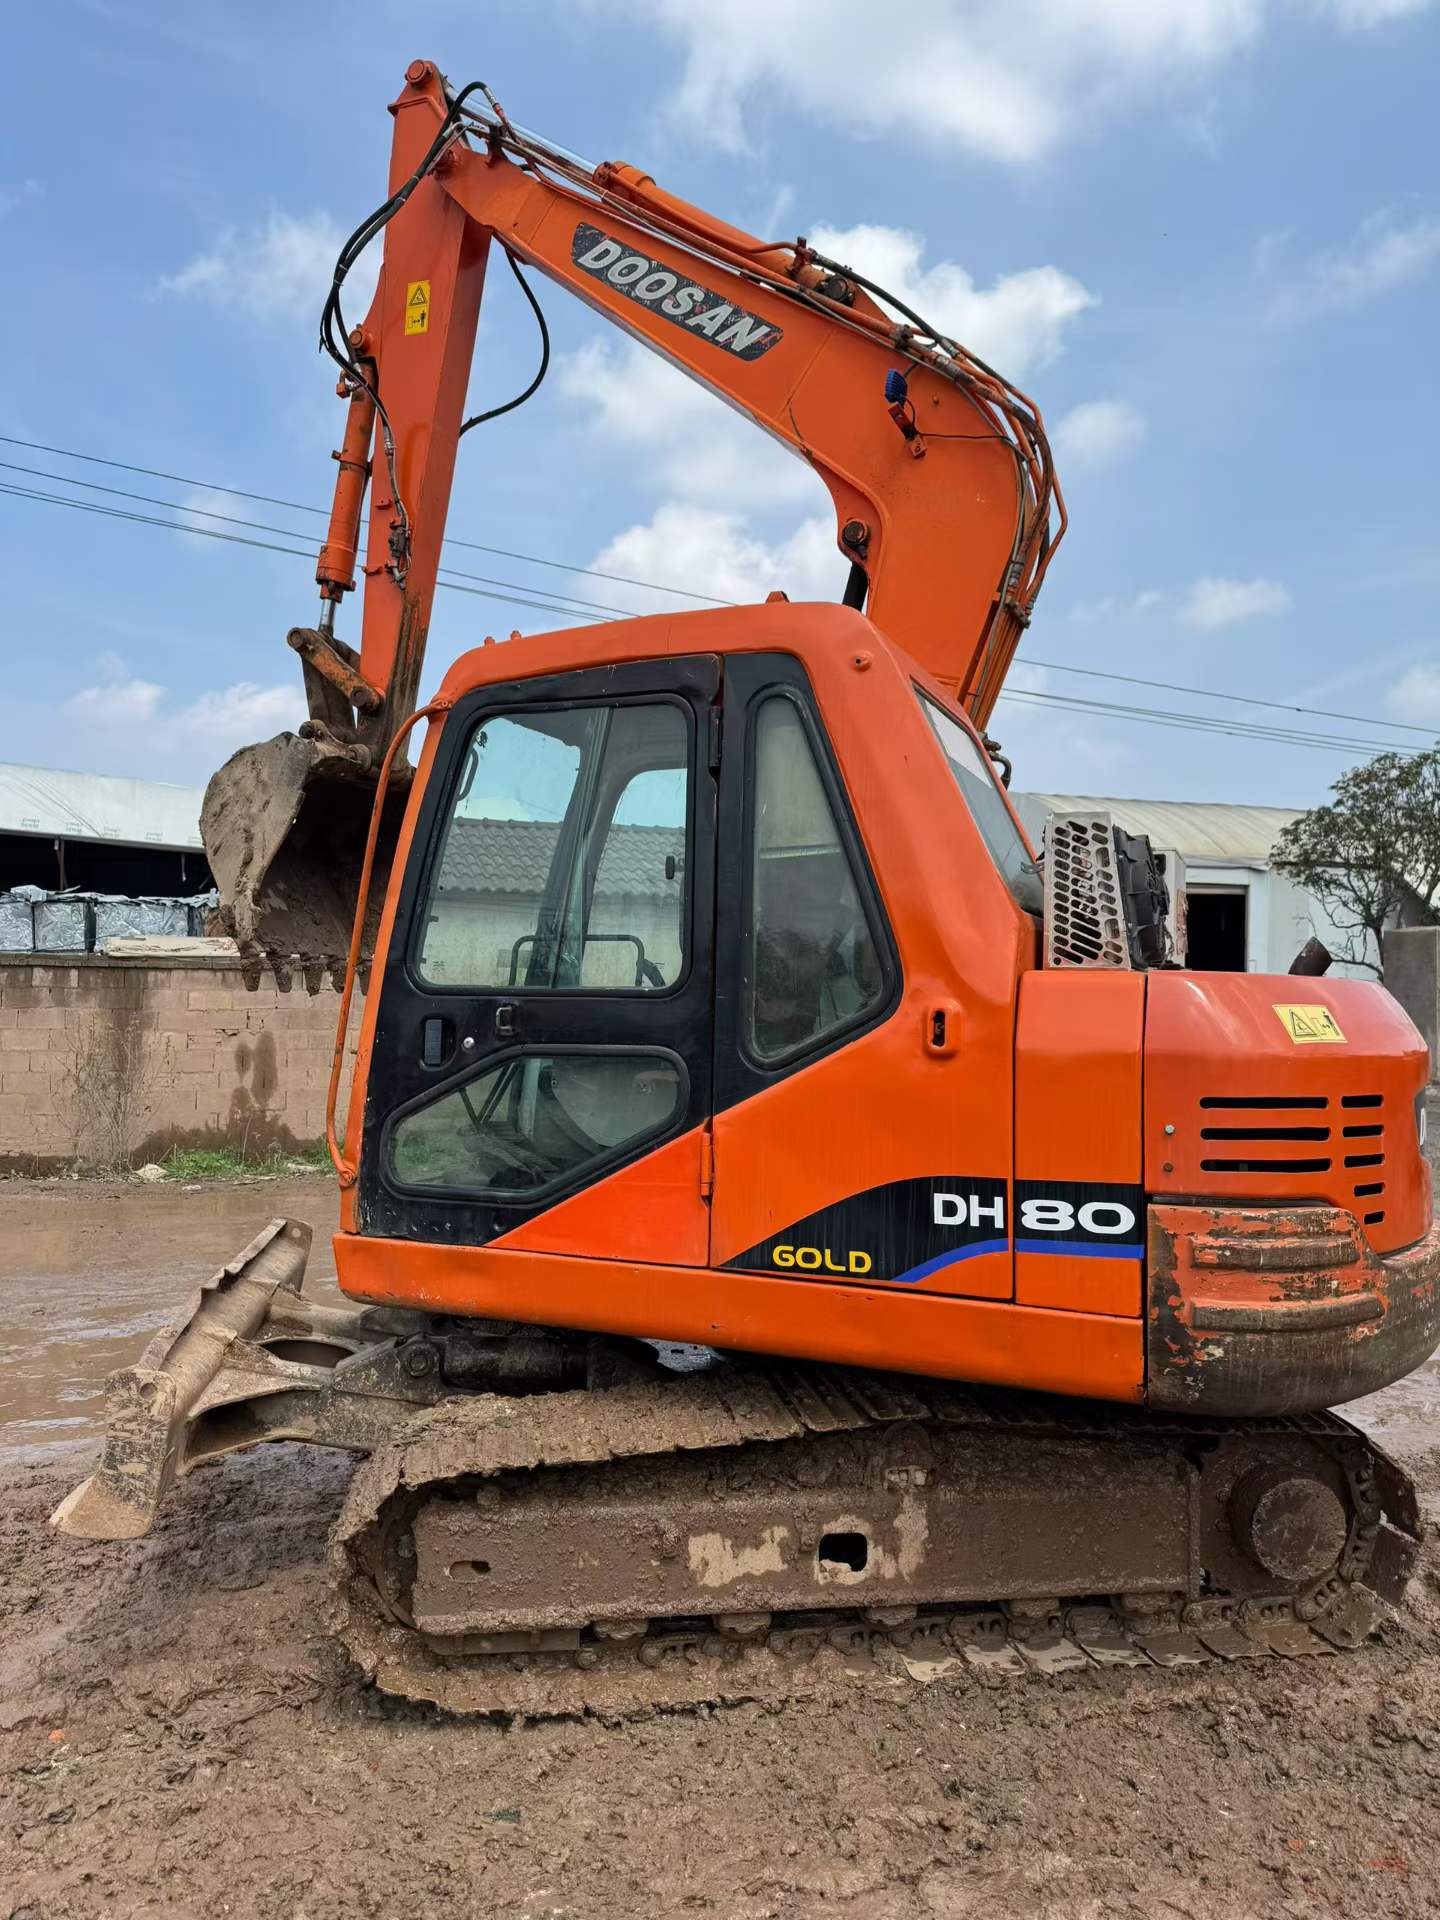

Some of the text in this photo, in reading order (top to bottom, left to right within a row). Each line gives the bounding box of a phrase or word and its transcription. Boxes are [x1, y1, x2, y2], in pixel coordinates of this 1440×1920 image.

[577, 238, 772, 352] DOOSAN
[933, 1192, 1137, 1235] DH 80
[772, 1245, 873, 1274] GOLD
